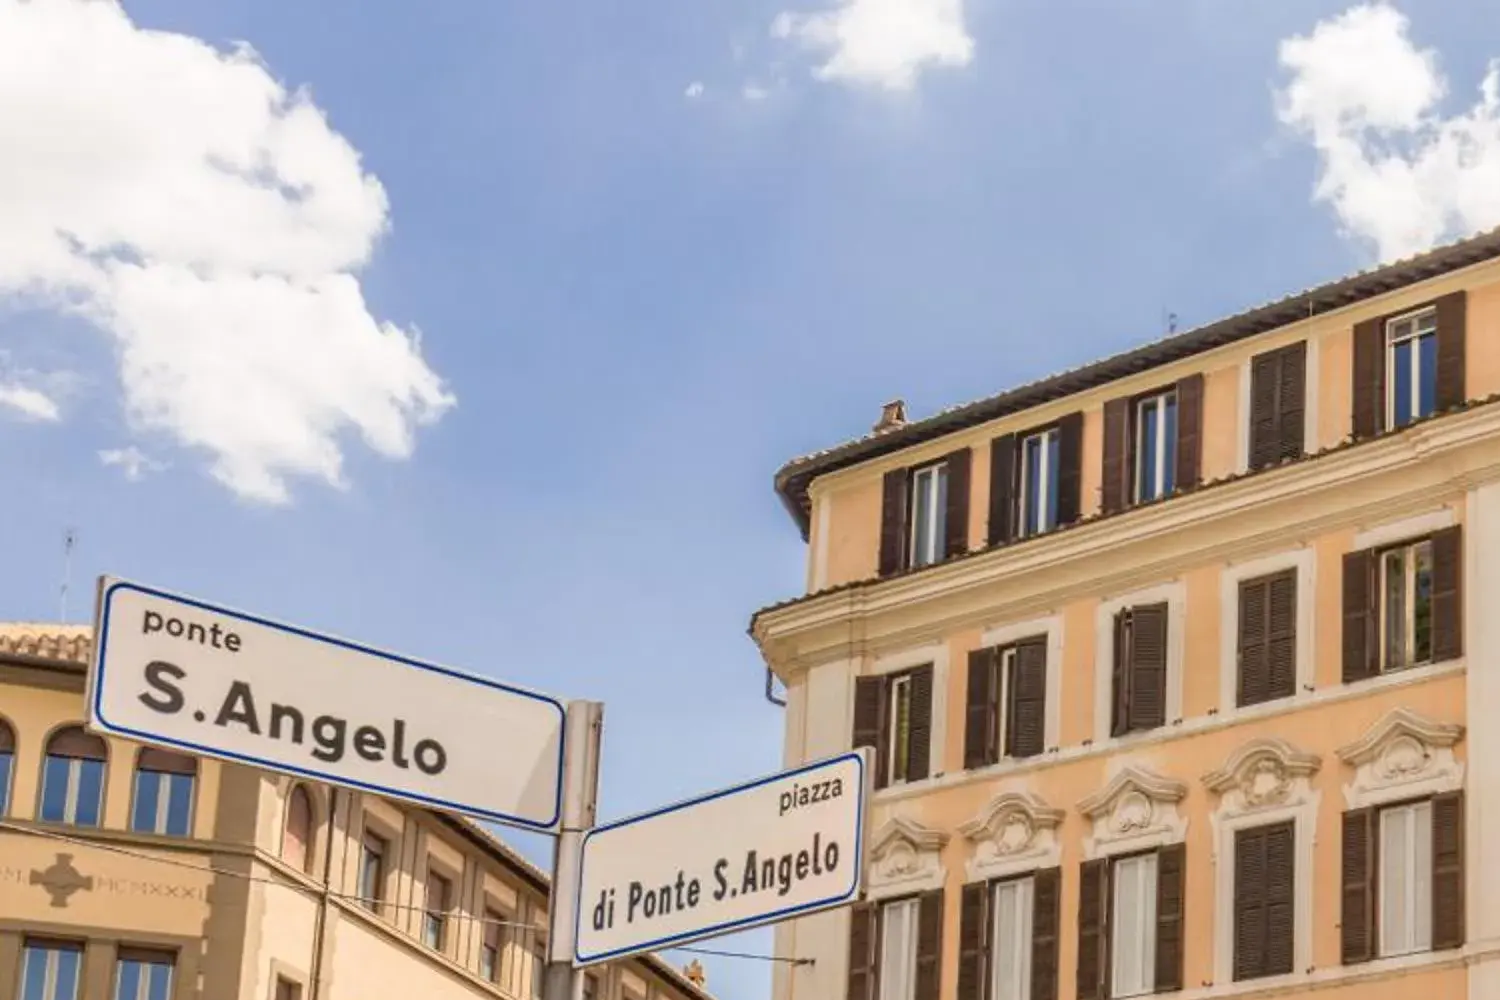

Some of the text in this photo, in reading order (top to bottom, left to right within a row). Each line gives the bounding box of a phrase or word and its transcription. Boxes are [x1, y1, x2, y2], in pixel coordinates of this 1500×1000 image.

[142, 609, 242, 652] ponte
[137, 660, 447, 775] S.Angelo
[779, 777, 843, 816] piazza
[593, 832, 839, 931] di Ponte S.Angelo
